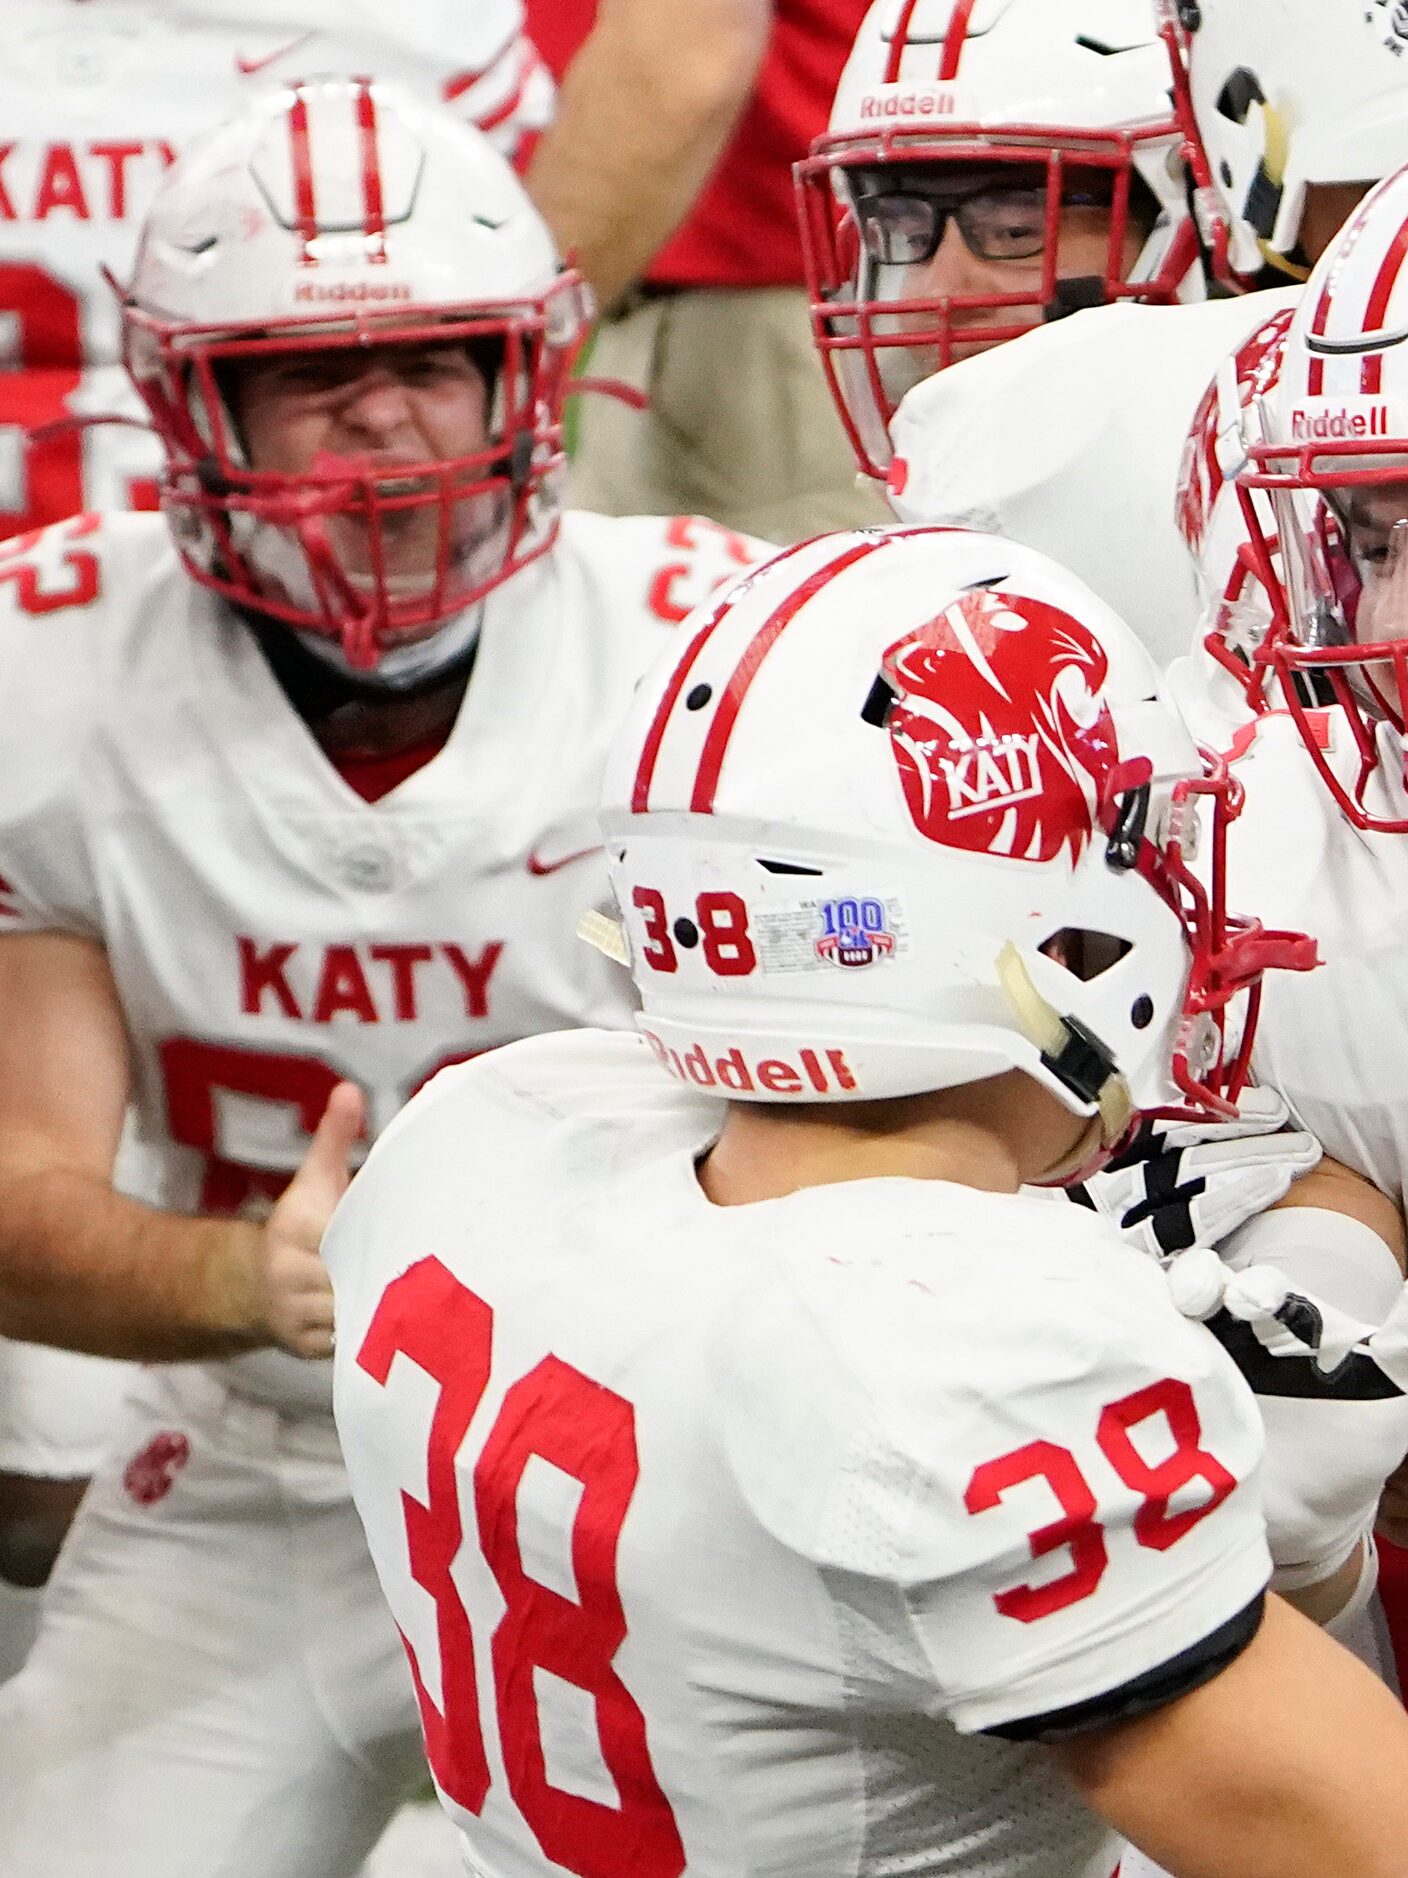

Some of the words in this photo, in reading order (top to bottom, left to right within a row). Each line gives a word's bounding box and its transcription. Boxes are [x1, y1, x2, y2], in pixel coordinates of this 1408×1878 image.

[860, 93, 955, 119] Riddell
[1292, 406, 1387, 439] Riddell
[938, 734, 1043, 820] KATY
[822, 896, 882, 935] 100
[236, 935, 507, 1023] KATY
[963, 1377, 1238, 1624] 38
[355, 1254, 688, 1878] 38
